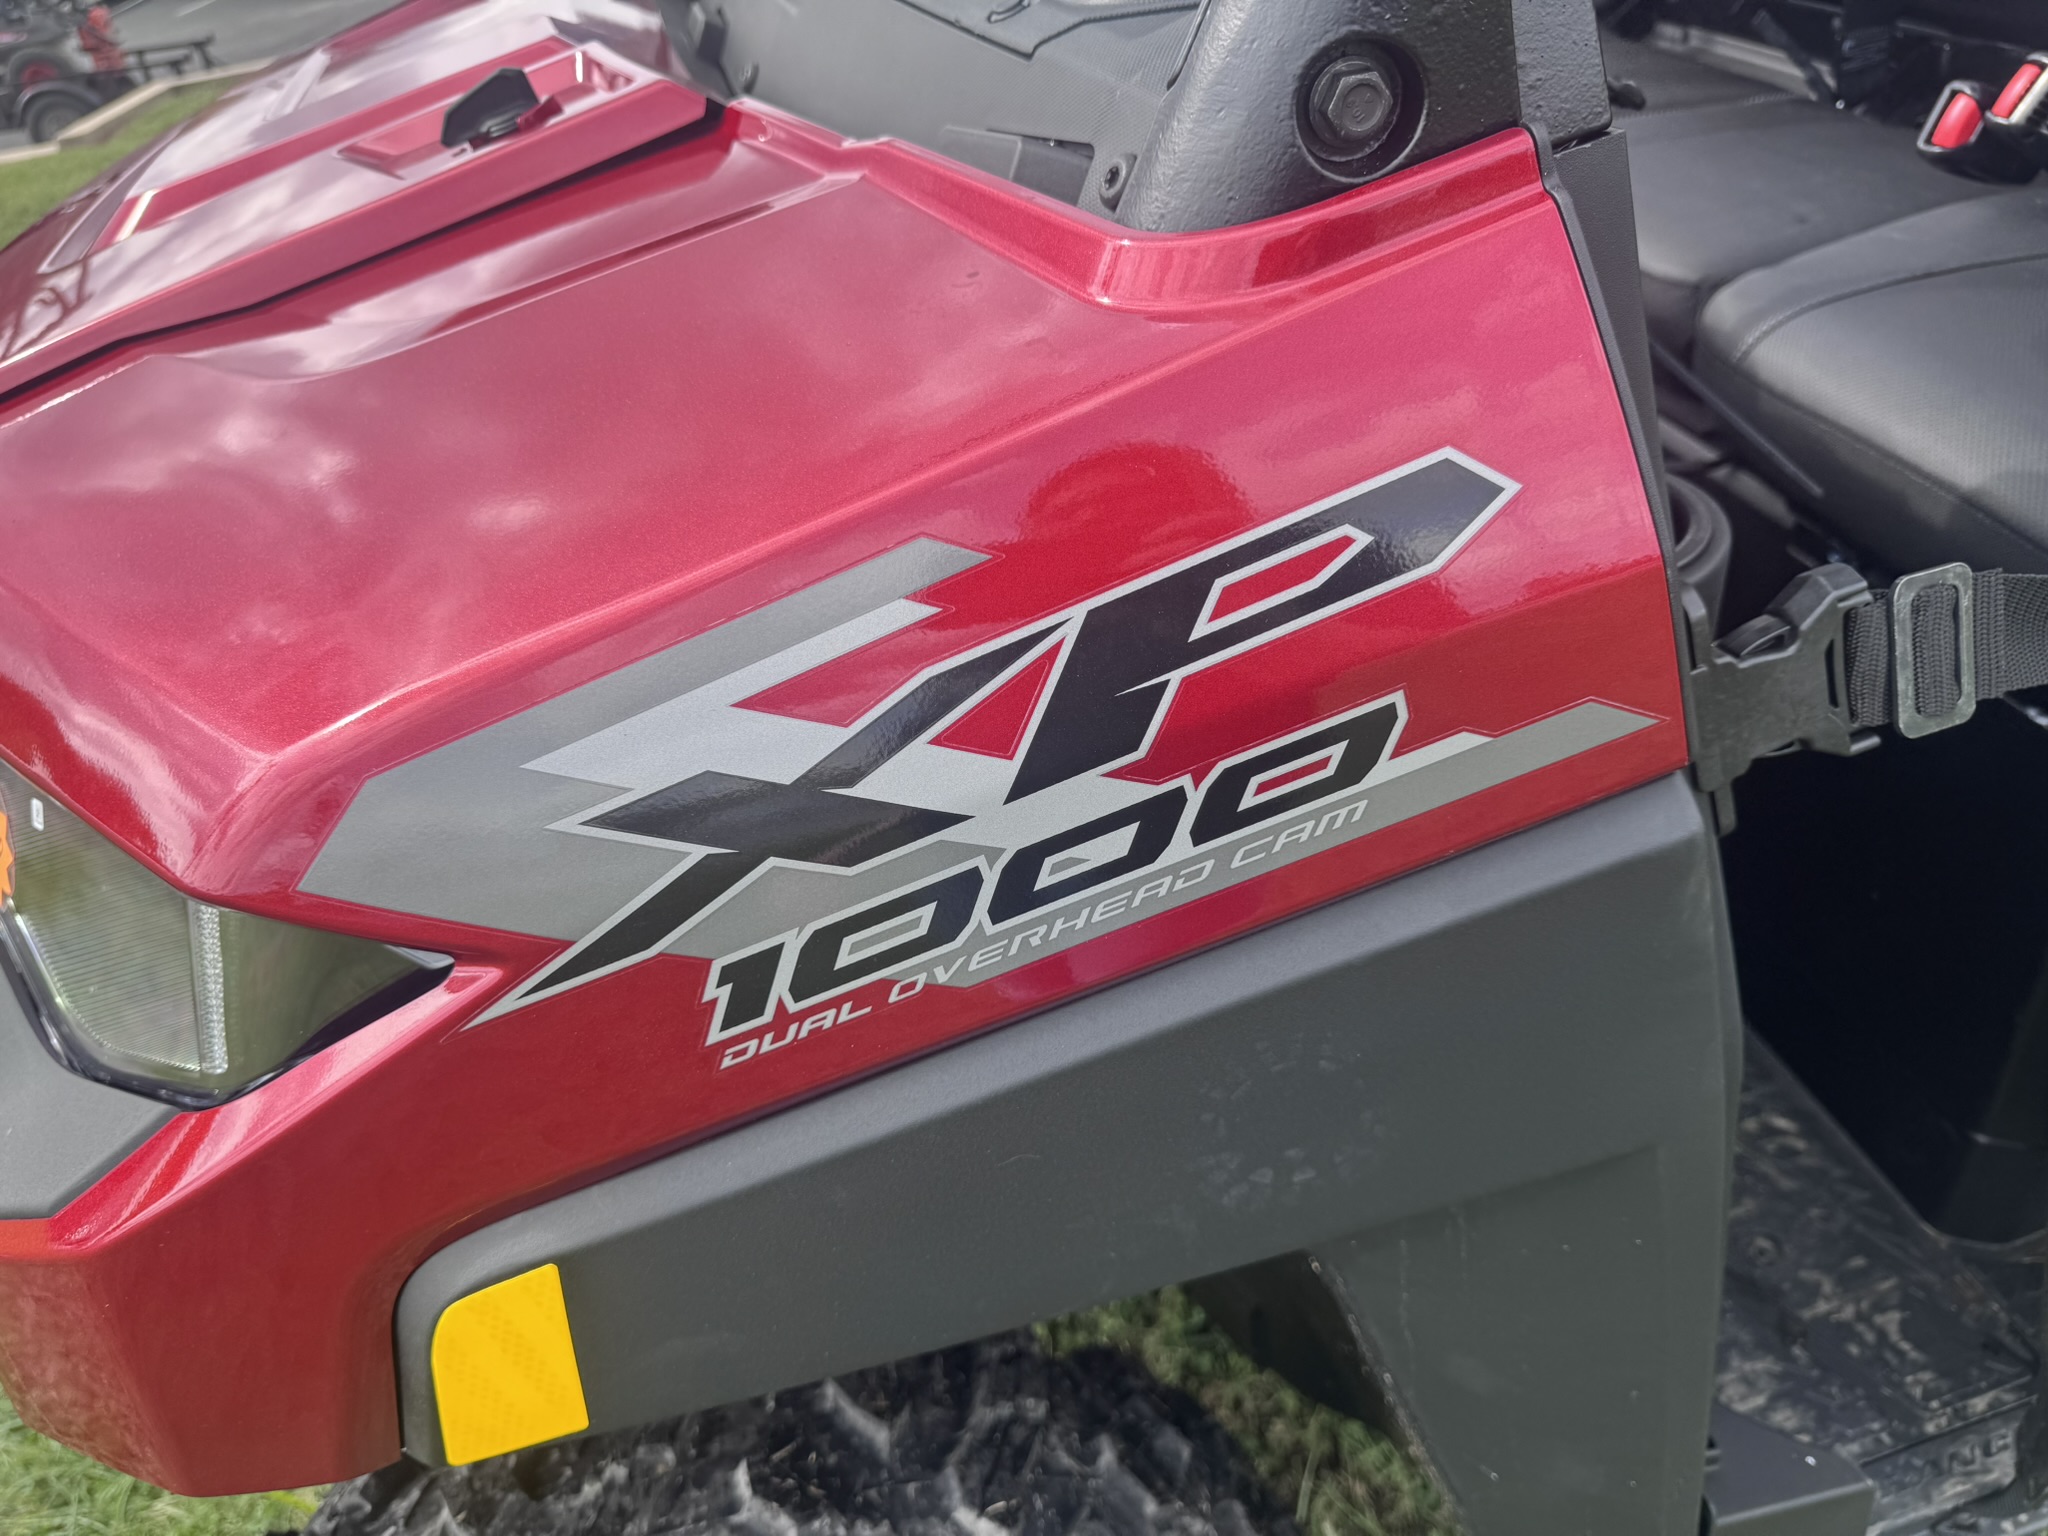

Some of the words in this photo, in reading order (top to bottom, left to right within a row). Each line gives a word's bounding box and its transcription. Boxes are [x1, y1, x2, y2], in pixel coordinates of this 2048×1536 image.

[467, 446, 1519, 1030] XP
[703, 691, 1409, 1046] 1000
[719, 1001, 872, 1070] DUAL
[888, 858, 1216, 1003] OVERHEAD
[1230, 799, 1369, 869] CAM
